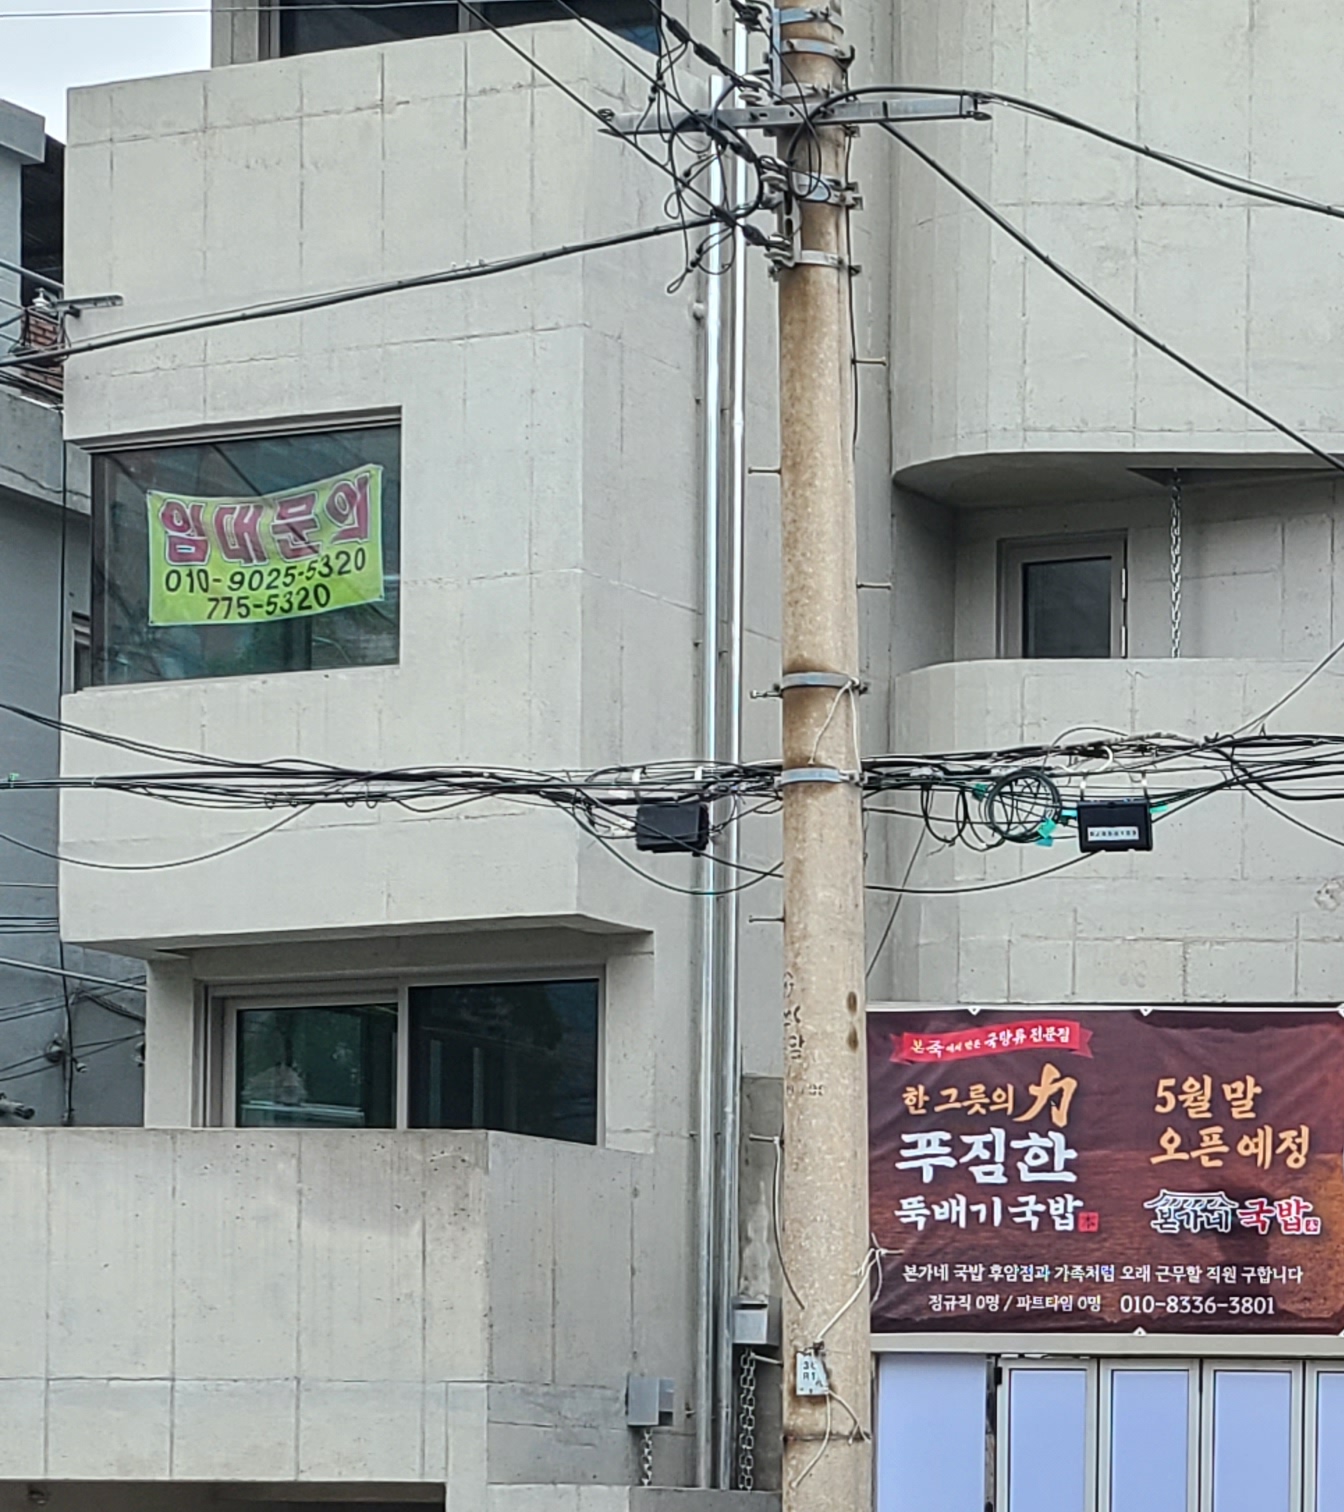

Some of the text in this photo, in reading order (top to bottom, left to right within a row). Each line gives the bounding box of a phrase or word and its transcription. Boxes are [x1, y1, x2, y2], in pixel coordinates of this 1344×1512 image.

[158, 473, 371, 567] 임대문의
[164, 547, 367, 593] 010-9025-5320
[206, 583, 331, 620] 775-5320
[984, 1029, 1027, 1049] 국탕류
[1029, 1025, 1071, 1043] 전문점
[901, 1082, 1015, 1116] 한 그릇의
[1012, 1062, 1078, 1128] 力
[1153, 1073, 1263, 1119] 5월 말
[894, 1126, 1079, 1185] 푸짐한
[1149, 1124, 1310, 1170] 오픈 예정
[1149, 1195, 1314, 1235] 본가네 국밥
[902, 1264, 1304, 1285] 본가네 국밥 후암점과 가족처럼 오래 근무할 직원 구합니다
[928, 1294, 972, 1312] 정규직
[1016, 1294, 1074, 1312] 파트타임
[1119, 1295, 1275, 1315] 010-8336-3801
